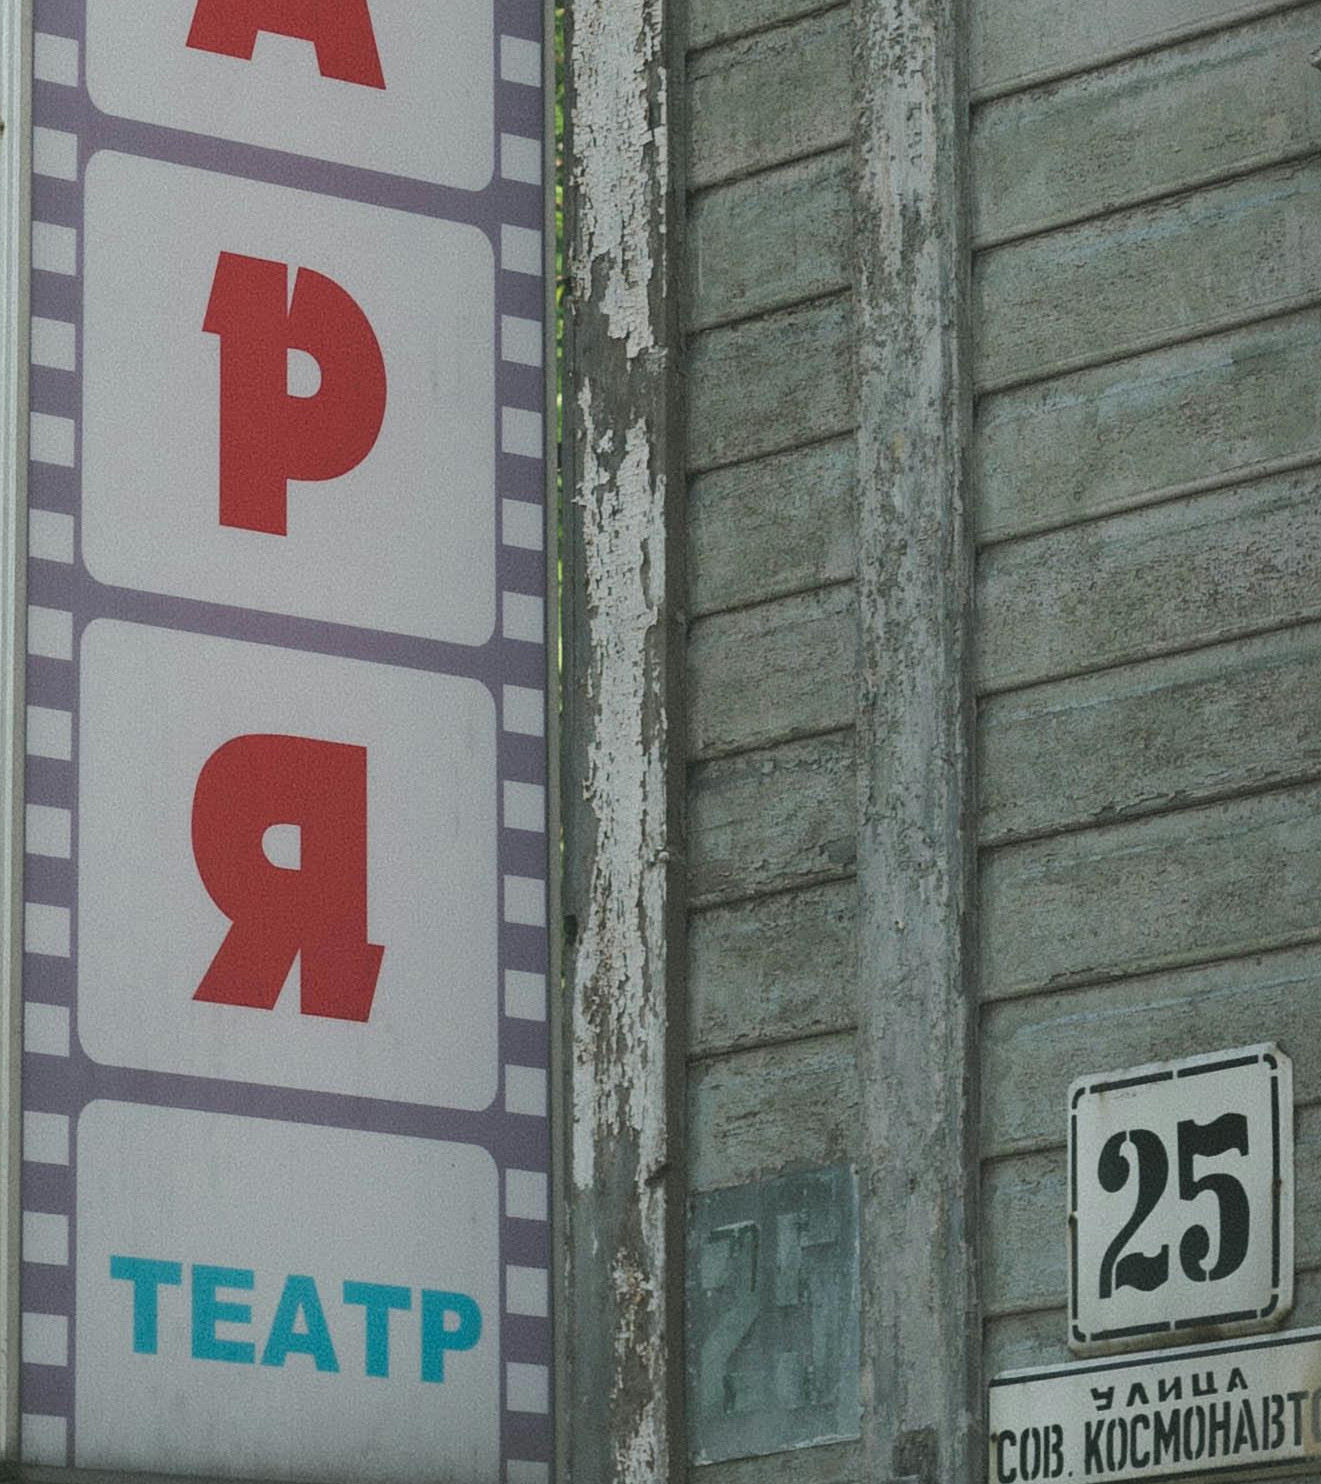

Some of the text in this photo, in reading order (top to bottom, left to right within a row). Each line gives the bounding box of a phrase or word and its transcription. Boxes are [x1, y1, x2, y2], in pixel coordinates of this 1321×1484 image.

[1097, 1112, 1251, 1299] 25
[109, 1254, 483, 1385] ТЕАТР
[1090, 1367, 1249, 1411] УЛИЦА
[996, 1423, 1074, 1484] СОВ.
